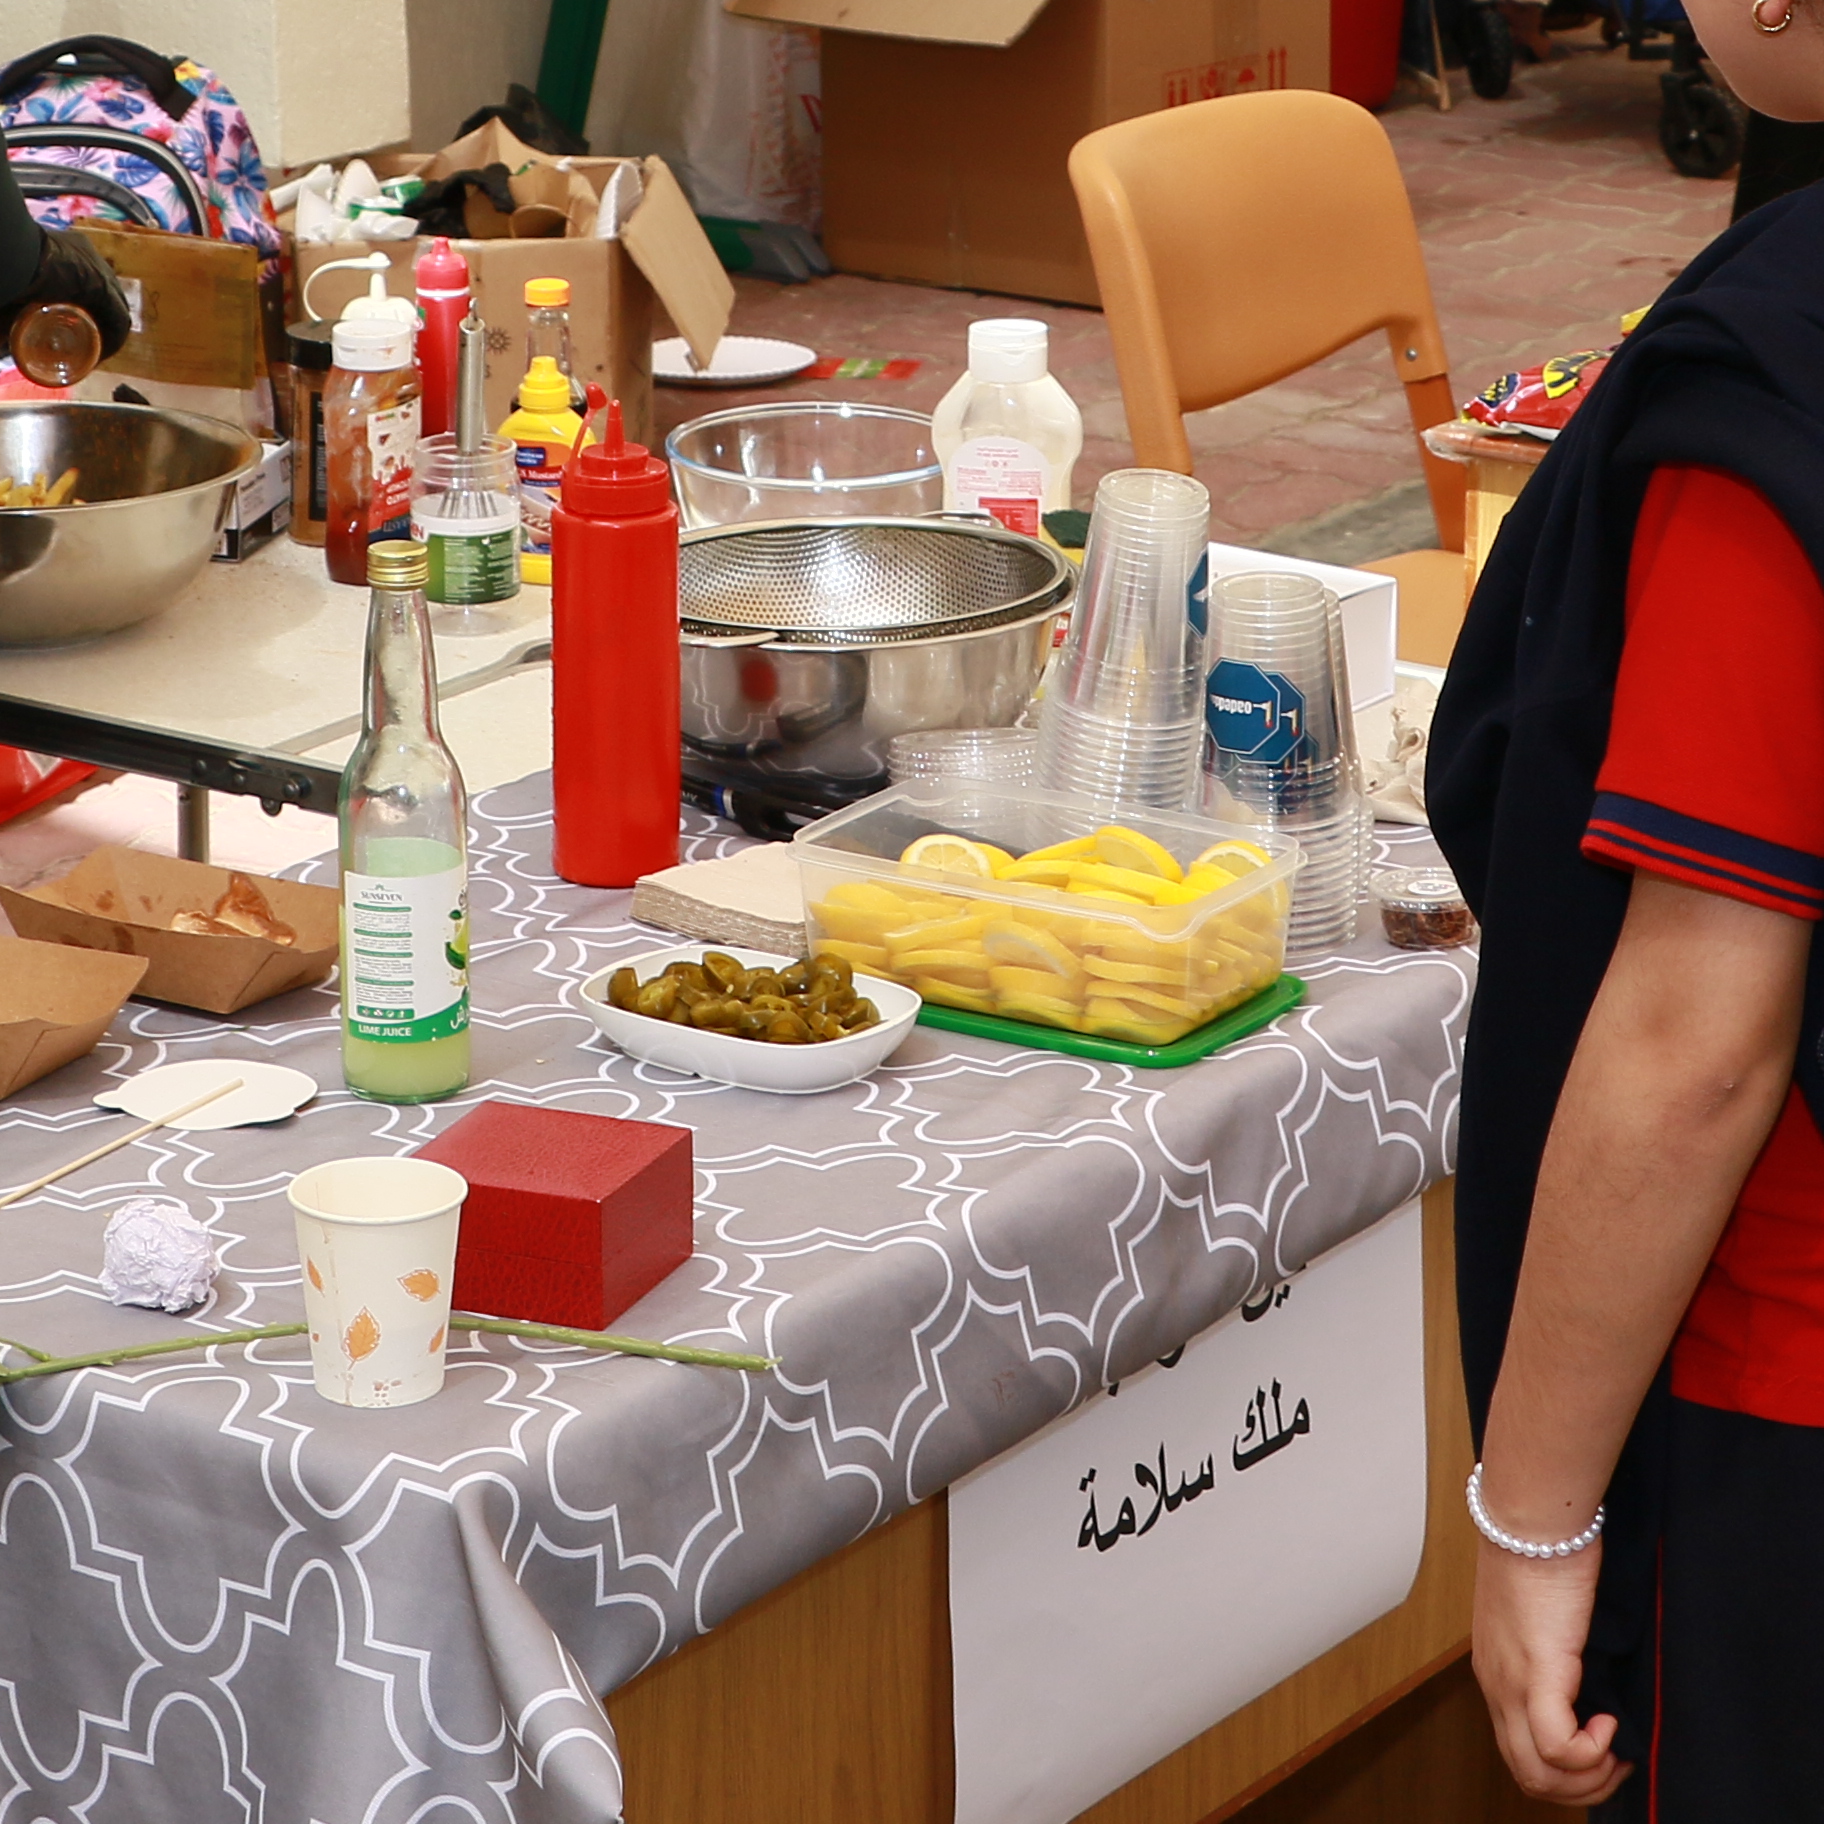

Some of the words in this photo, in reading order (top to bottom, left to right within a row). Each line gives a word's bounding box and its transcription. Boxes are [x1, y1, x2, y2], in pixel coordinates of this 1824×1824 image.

[361, 890, 403, 902] SUNSEVEN
[358, 1024, 381, 1036] LIME
[382, 1025, 412, 1037] JUICE
[1232, 1377, 1311, 1472] ملك
[1078, 1441, 1215, 1553] سلامة
